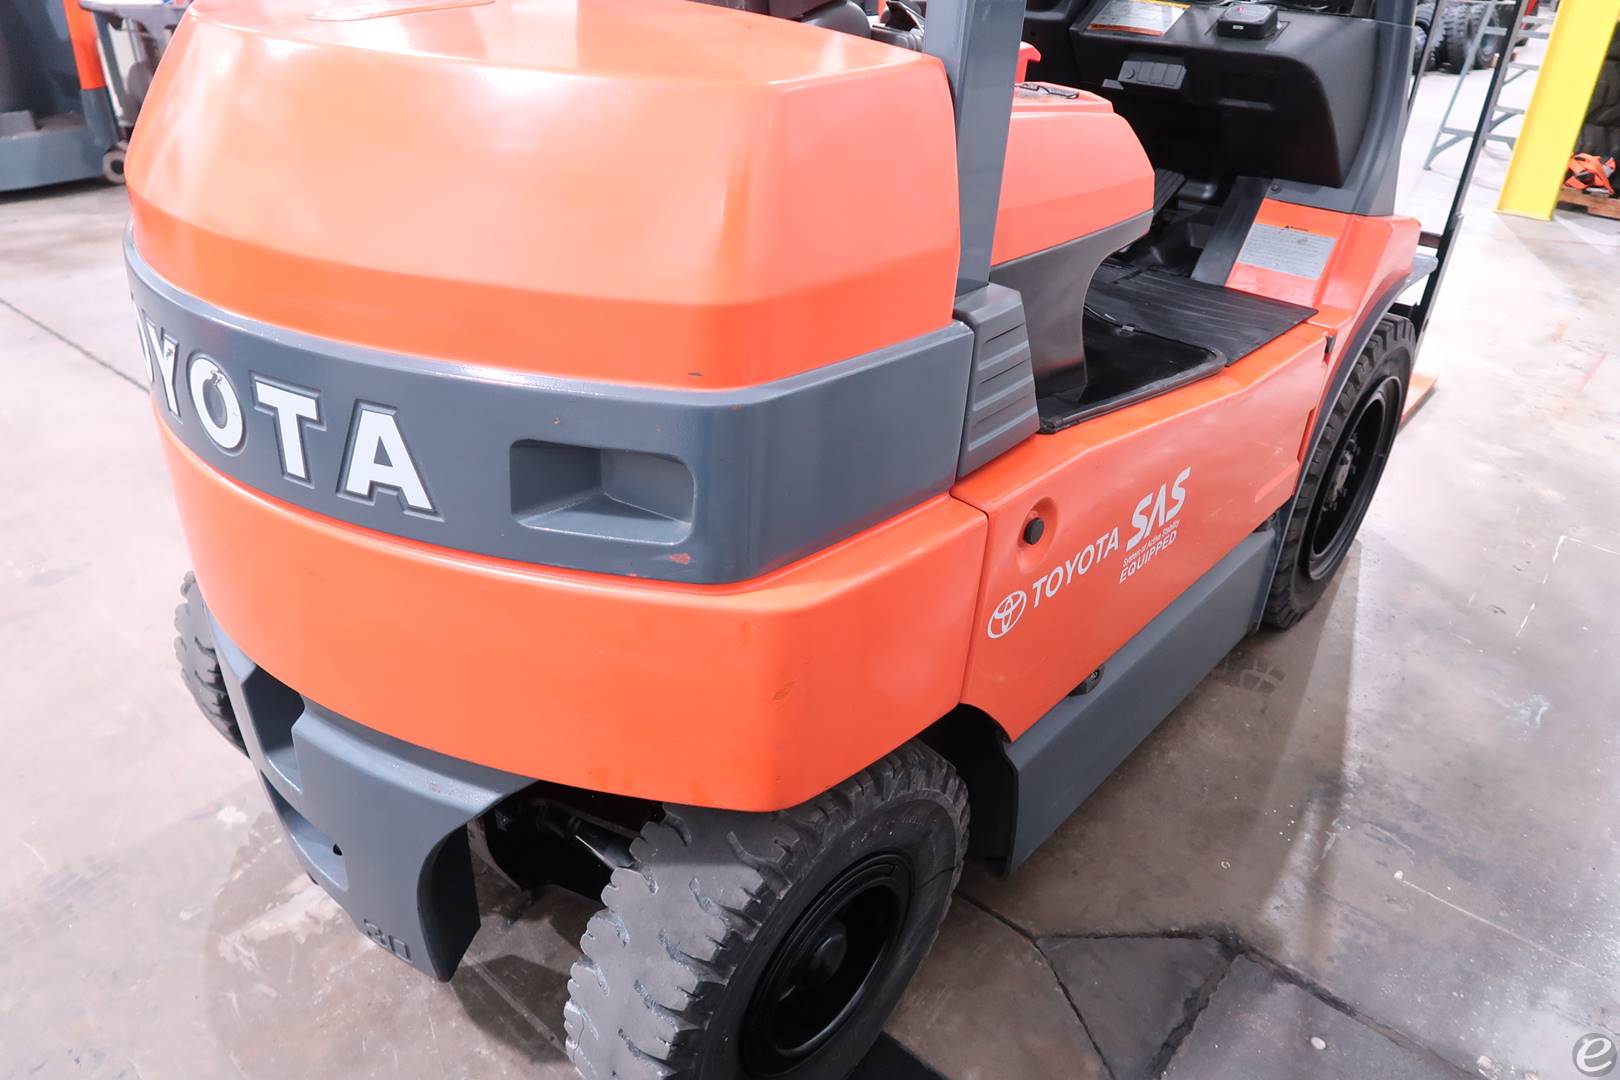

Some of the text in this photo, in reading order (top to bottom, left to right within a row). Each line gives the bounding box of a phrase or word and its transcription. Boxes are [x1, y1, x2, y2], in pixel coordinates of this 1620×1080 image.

[133, 302, 434, 511] YOTA
[1126, 466, 1191, 551] SAS
[1032, 527, 1119, 608] TOYOTA
[1119, 530, 1177, 583] EQUIPPED
